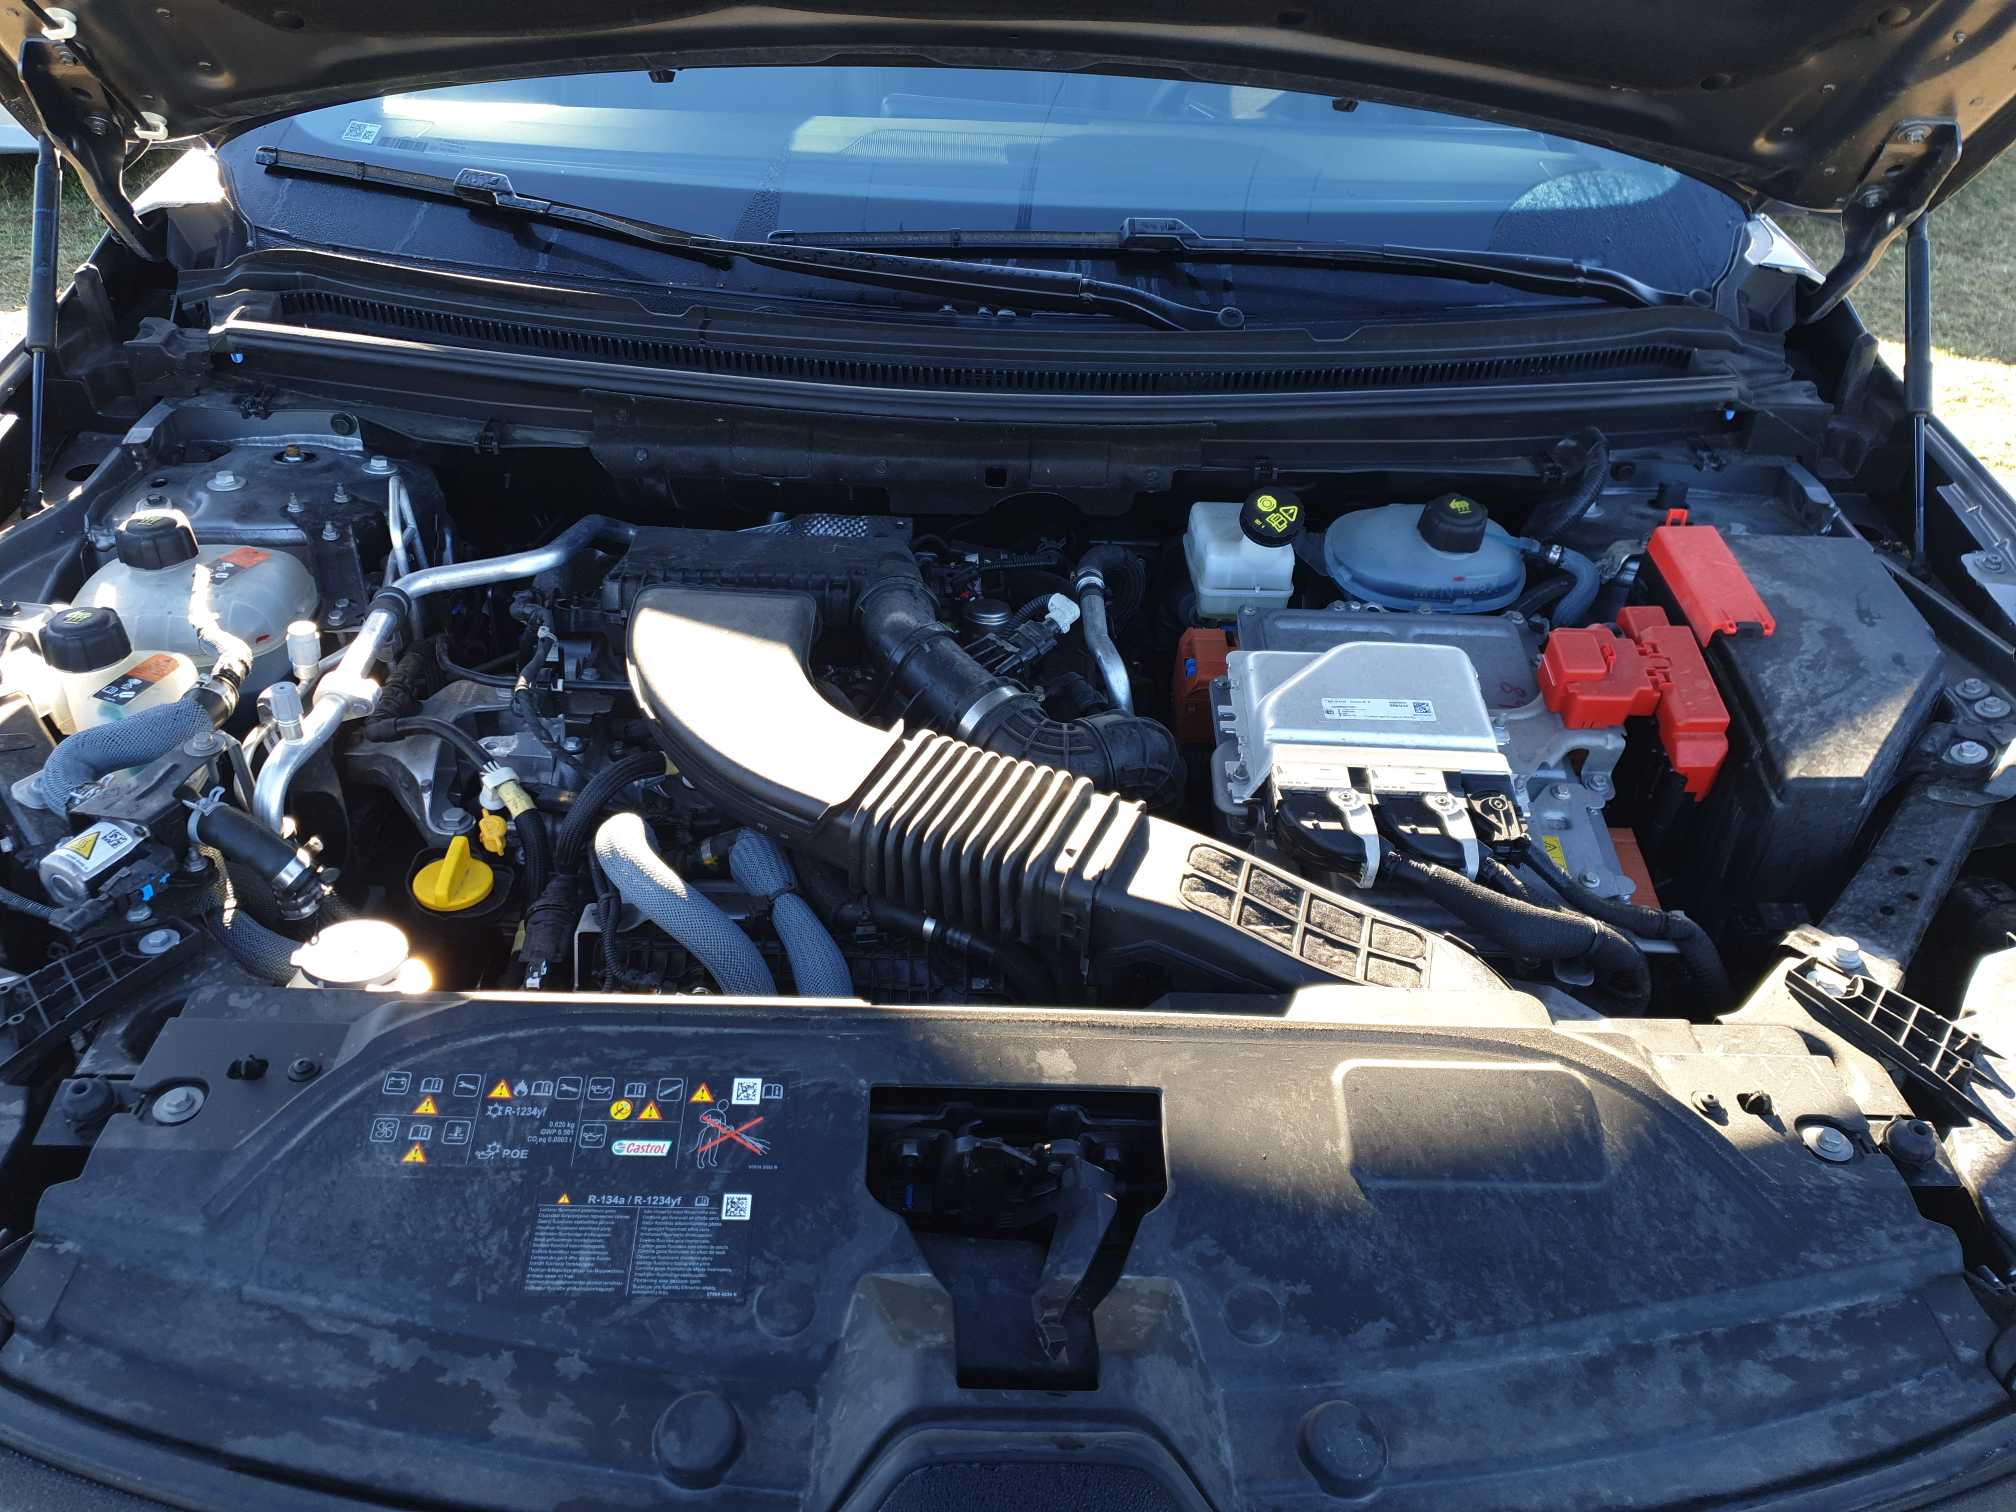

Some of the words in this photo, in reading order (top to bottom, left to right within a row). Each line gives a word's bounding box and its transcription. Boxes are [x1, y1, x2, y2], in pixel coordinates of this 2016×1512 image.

[504, 1106, 548, 1118] R-1234yf
[567, 1121, 575, 1130] kg
[502, 1149, 529, 1159] POE
[626, 1142, 666, 1154] Castrol
[588, 1194, 625, 1205] R-134a
[634, 1195, 682, 1208] R-1234yf
